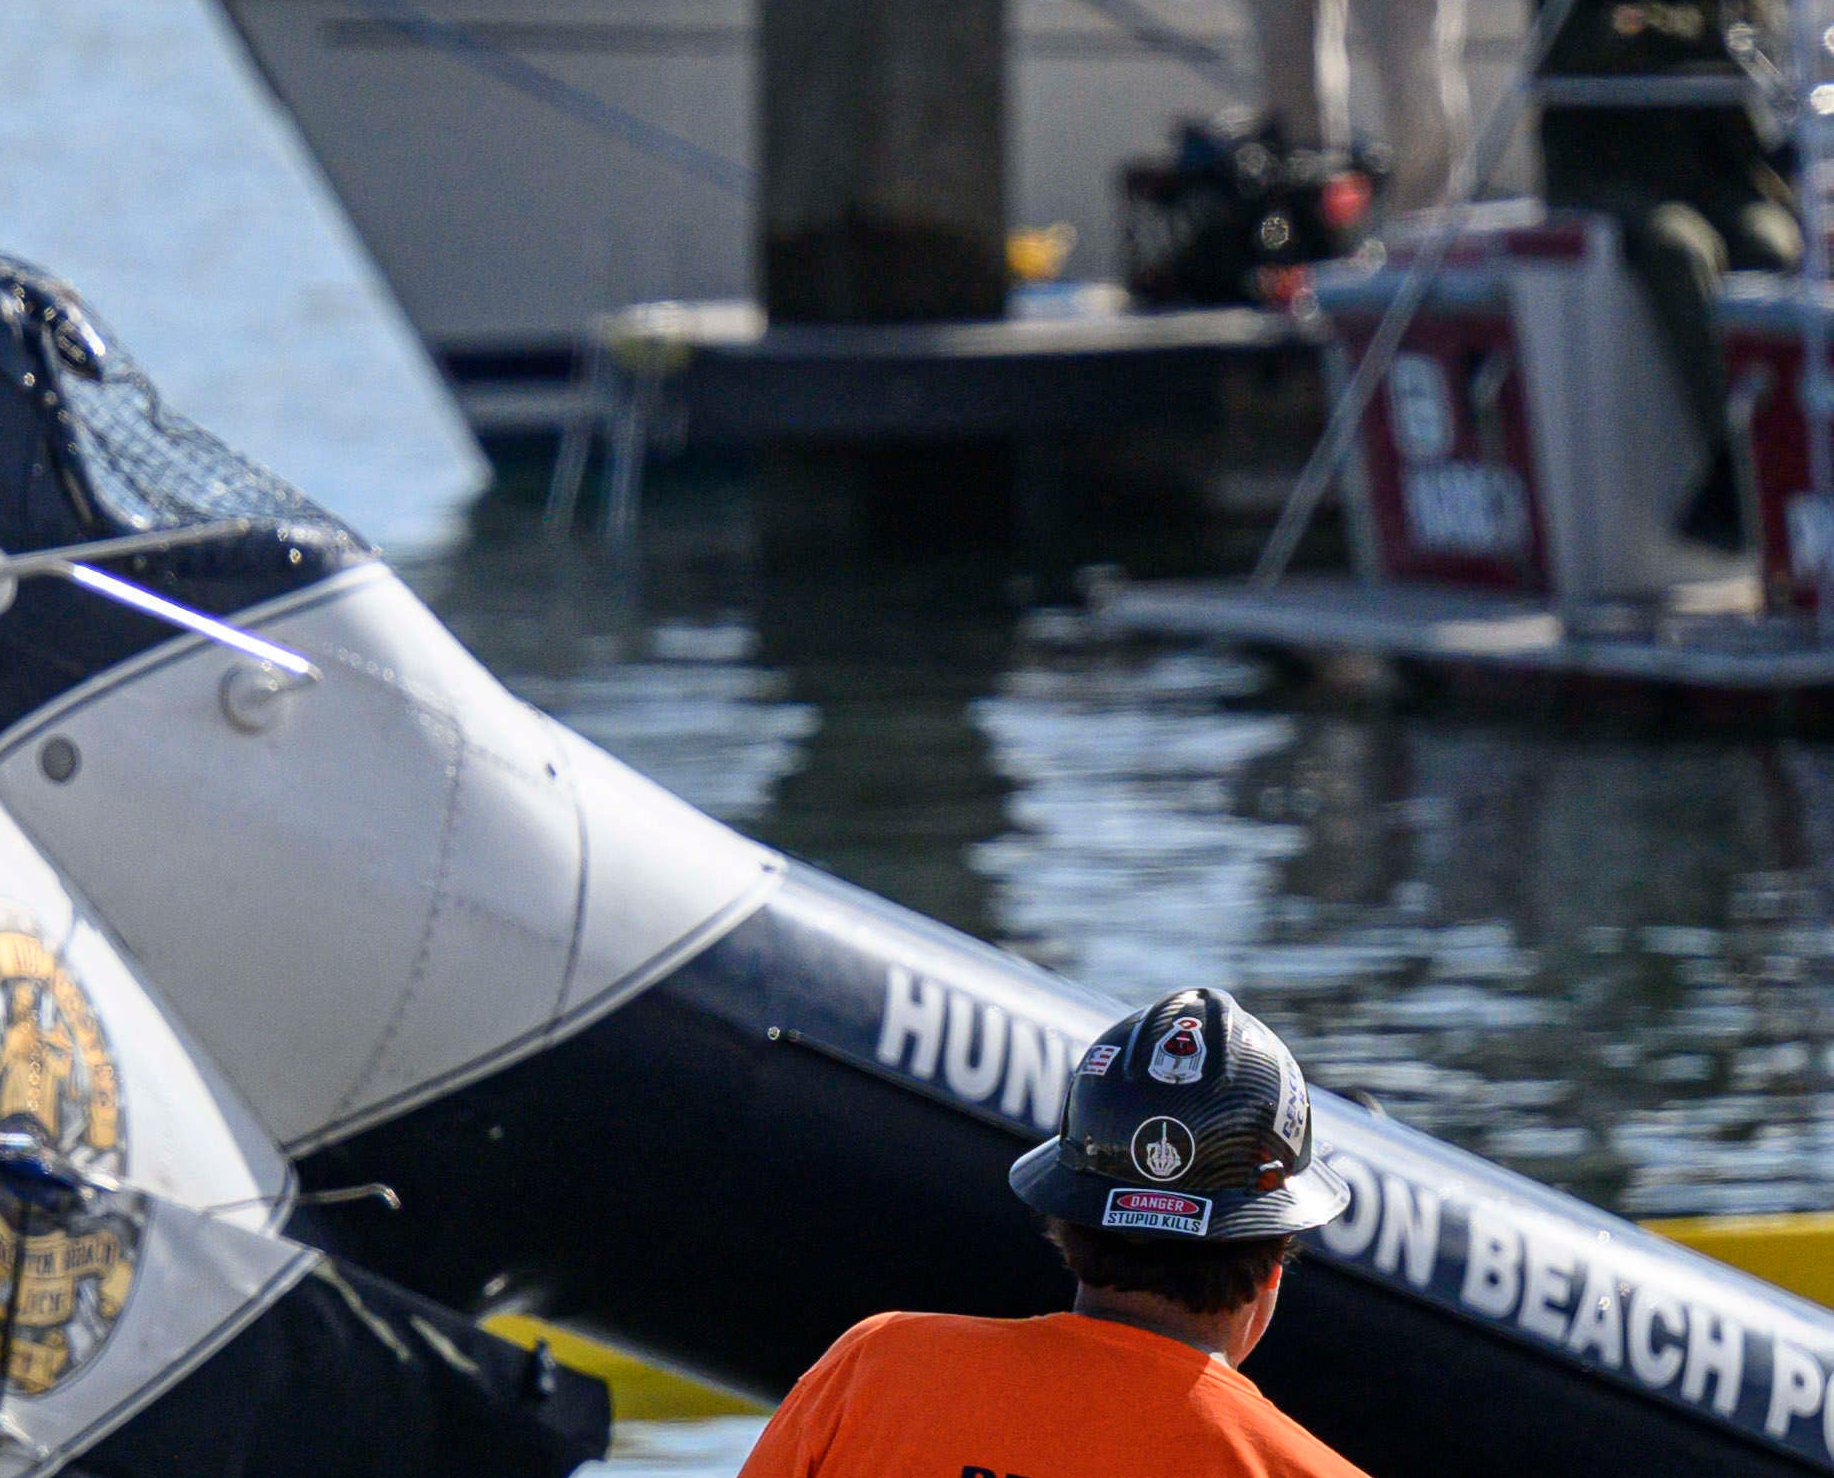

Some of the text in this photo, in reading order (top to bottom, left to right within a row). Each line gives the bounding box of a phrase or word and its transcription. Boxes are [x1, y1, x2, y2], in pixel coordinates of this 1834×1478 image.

[1130, 1195, 1185, 1213] DANGER
[1107, 1211, 1202, 1233] STUPID KILLS
[1460, 1213, 1745, 1421] BEACH
[1763, 1339, 1834, 1473] P
